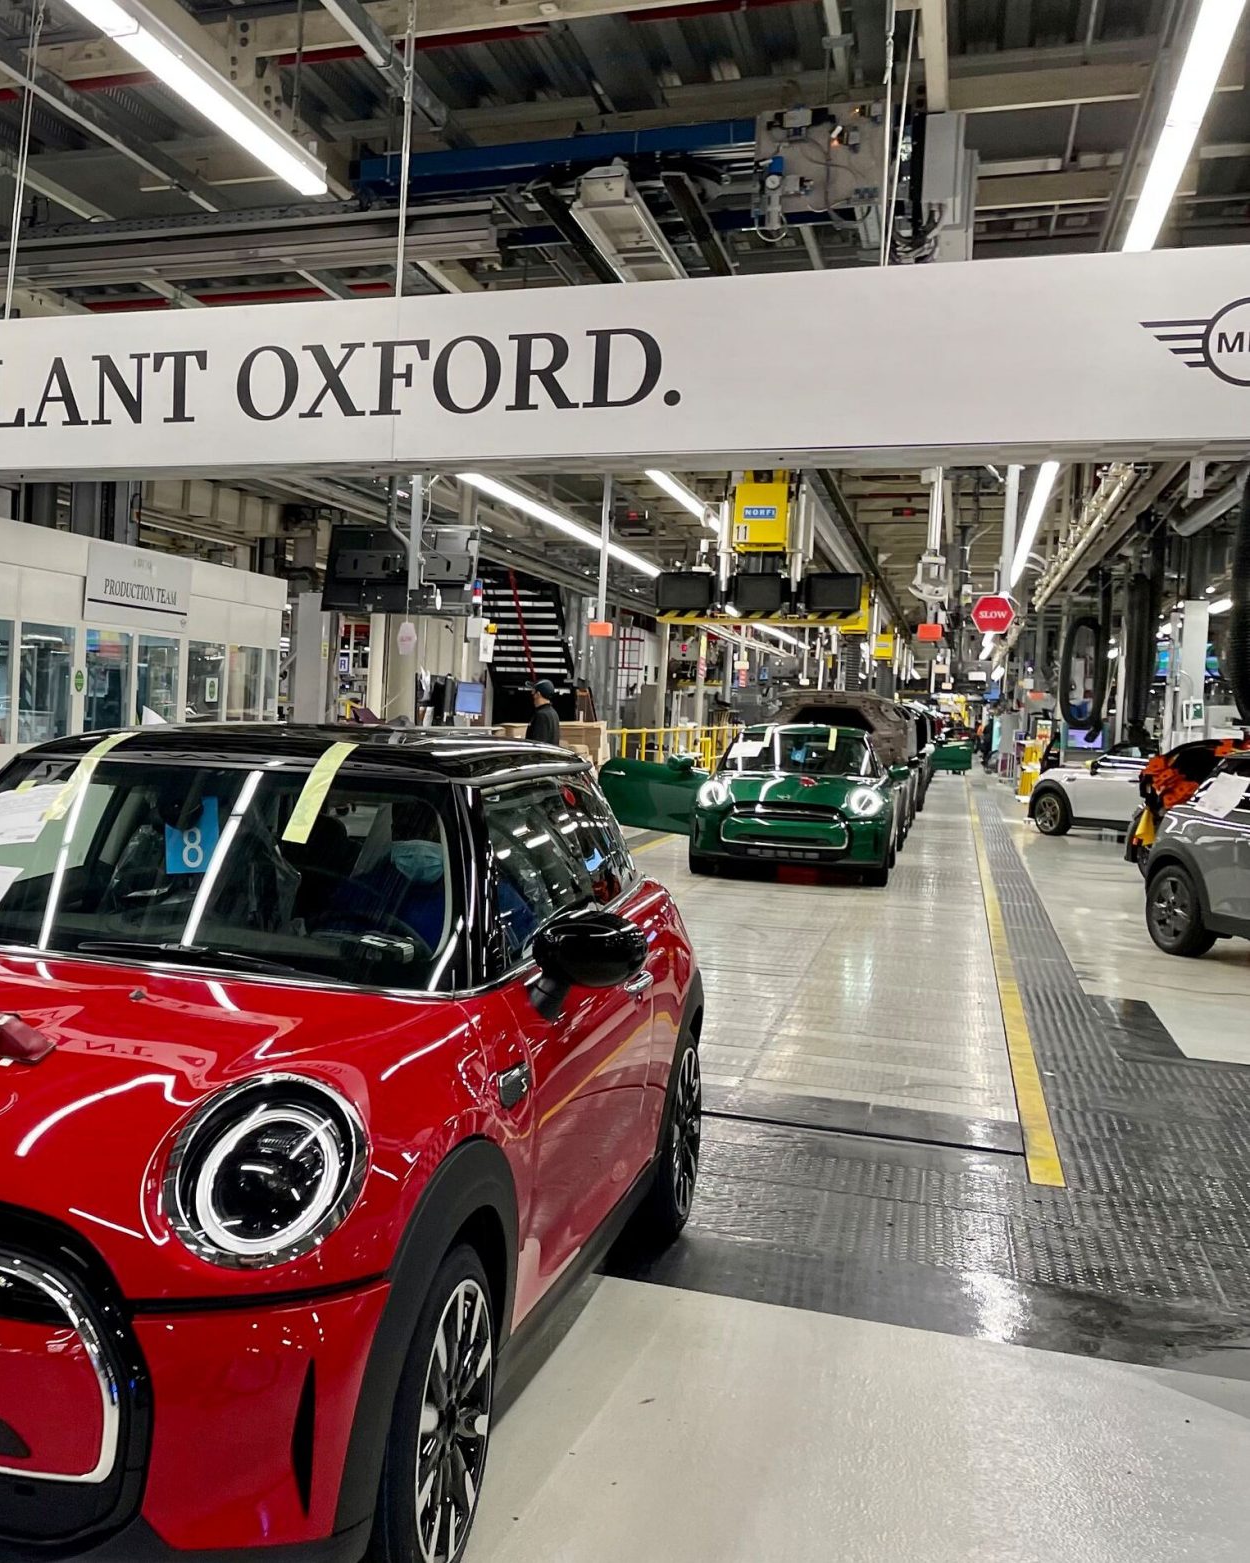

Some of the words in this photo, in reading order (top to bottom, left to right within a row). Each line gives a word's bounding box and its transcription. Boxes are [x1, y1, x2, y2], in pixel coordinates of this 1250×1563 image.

[1217, 331, 1250, 353] M
[236, 327, 682, 421] OXFORD.
[103, 578, 155, 602] PRODUCTION
[155, 588, 177, 606] TEAM
[979, 610, 1008, 619] SLOW
[182, 827, 204, 868] 8
